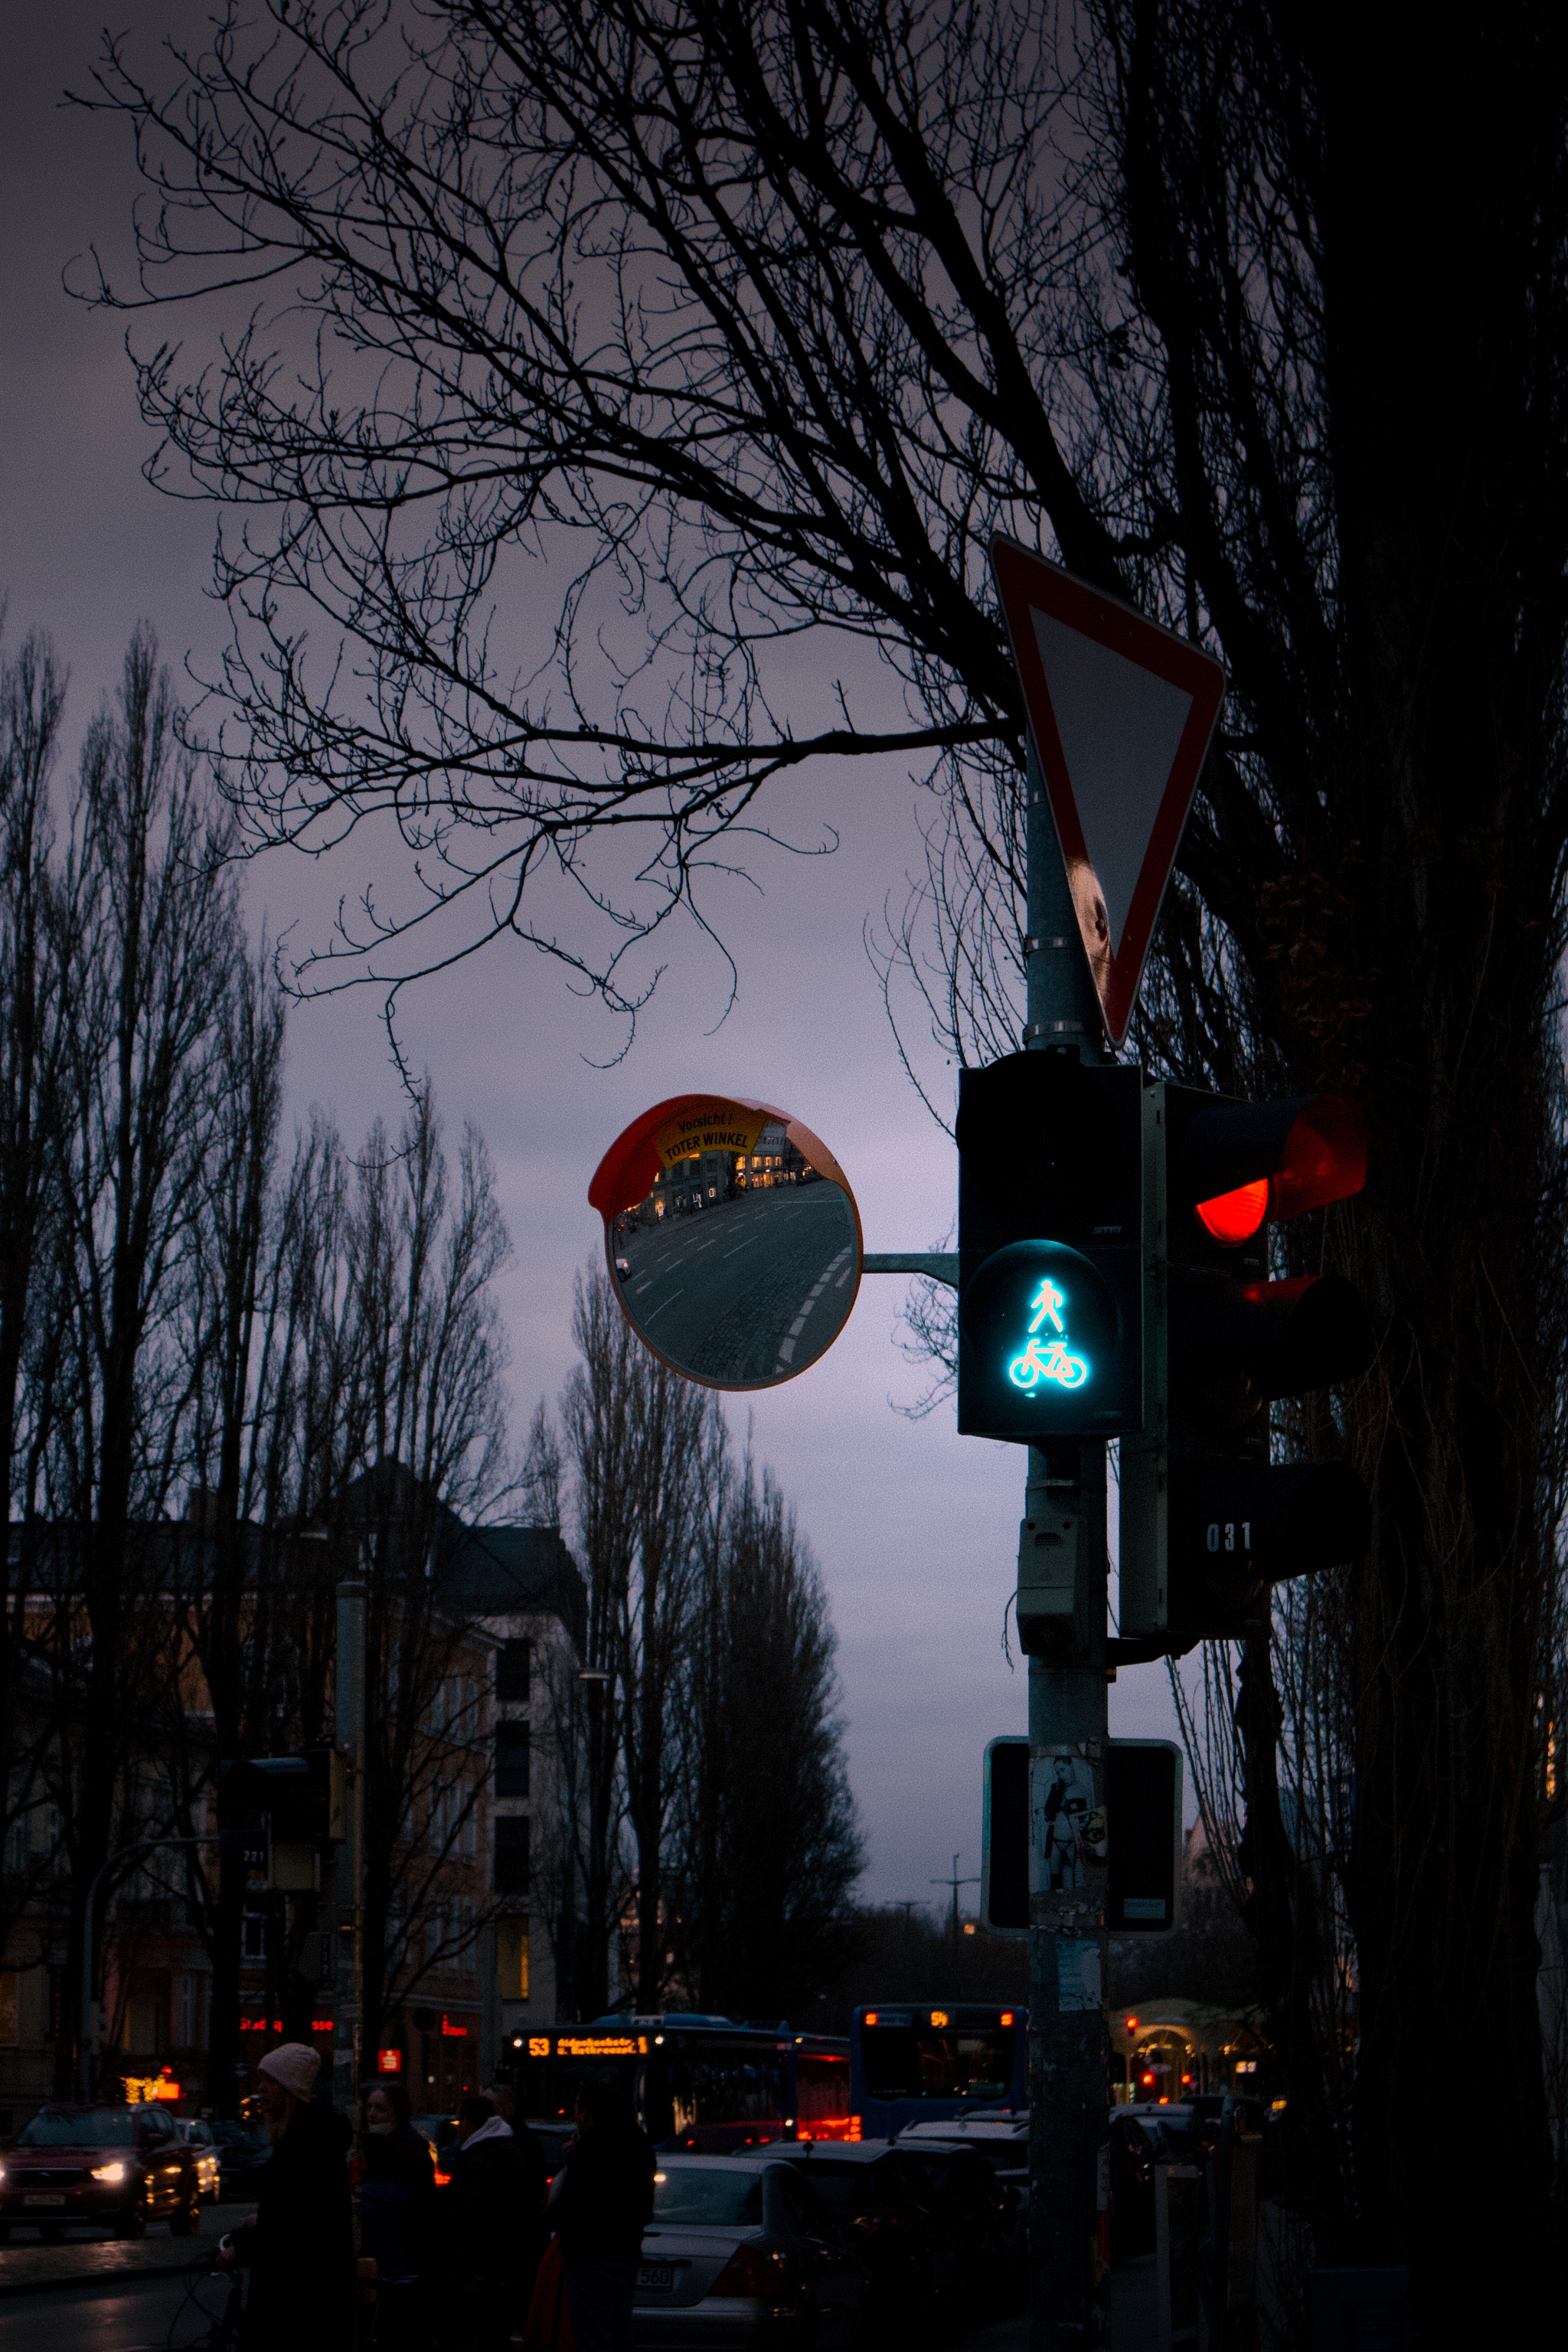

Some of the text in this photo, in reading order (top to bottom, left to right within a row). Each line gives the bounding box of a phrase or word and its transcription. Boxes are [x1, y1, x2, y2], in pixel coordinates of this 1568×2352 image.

[678, 1112, 726, 1133] Vorsicht
[665, 1132, 748, 1161] TOTER WINKEL
[1206, 1521, 1252, 1553] 031
[243, 1850, 265, 1863] 221
[931, 2011, 948, 2027] 54
[529, 2038, 550, 2056] 53
[640, 2269, 668, 2285] 560
